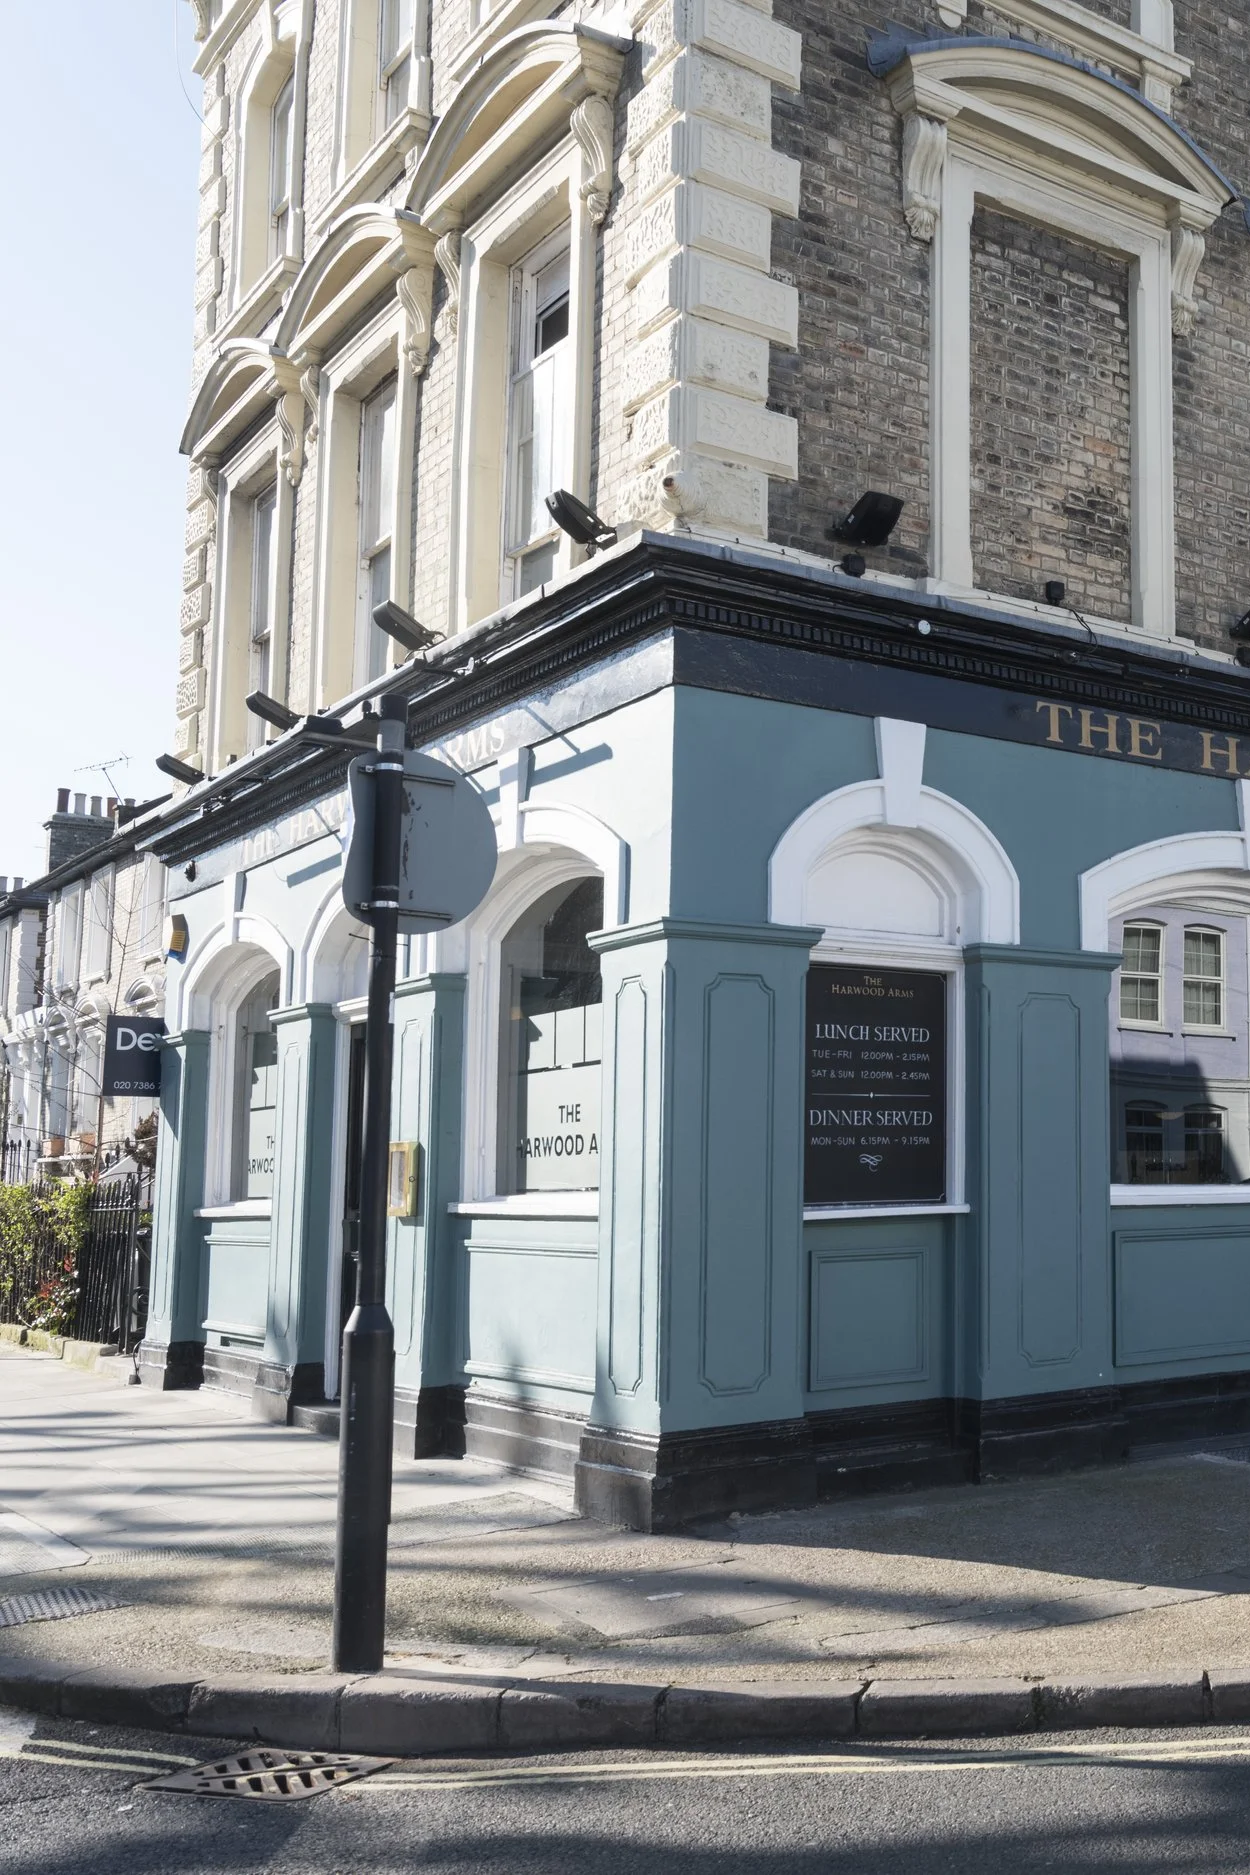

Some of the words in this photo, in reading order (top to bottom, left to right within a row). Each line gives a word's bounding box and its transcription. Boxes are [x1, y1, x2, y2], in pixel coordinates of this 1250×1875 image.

[1036, 700, 1163, 762] THE
[864, 976, 882, 986] THE
[832, 984, 884, 997] HARWOOD
[888, 988, 914, 998] ARMS
[816, 1024, 869, 1040] LUNCH
[874, 1026, 930, 1042] SERVED
[811, 1069, 827, 1078] SAT
[830, 1070, 836, 1078] &
[838, 1071, 854, 1079] SUN
[861, 1071, 893, 1079] 12.00PM
[901, 1072, 930, 1080] 2.45PM
[113, 1081, 131, 1089] 020
[559, 1104, 581, 1123] THE
[809, 1110, 874, 1126] DINNER
[876, 1110, 933, 1126] SERVED
[861, 1137, 890, 1145] 6.15PM
[902, 1137, 930, 1145] 9.15PM
